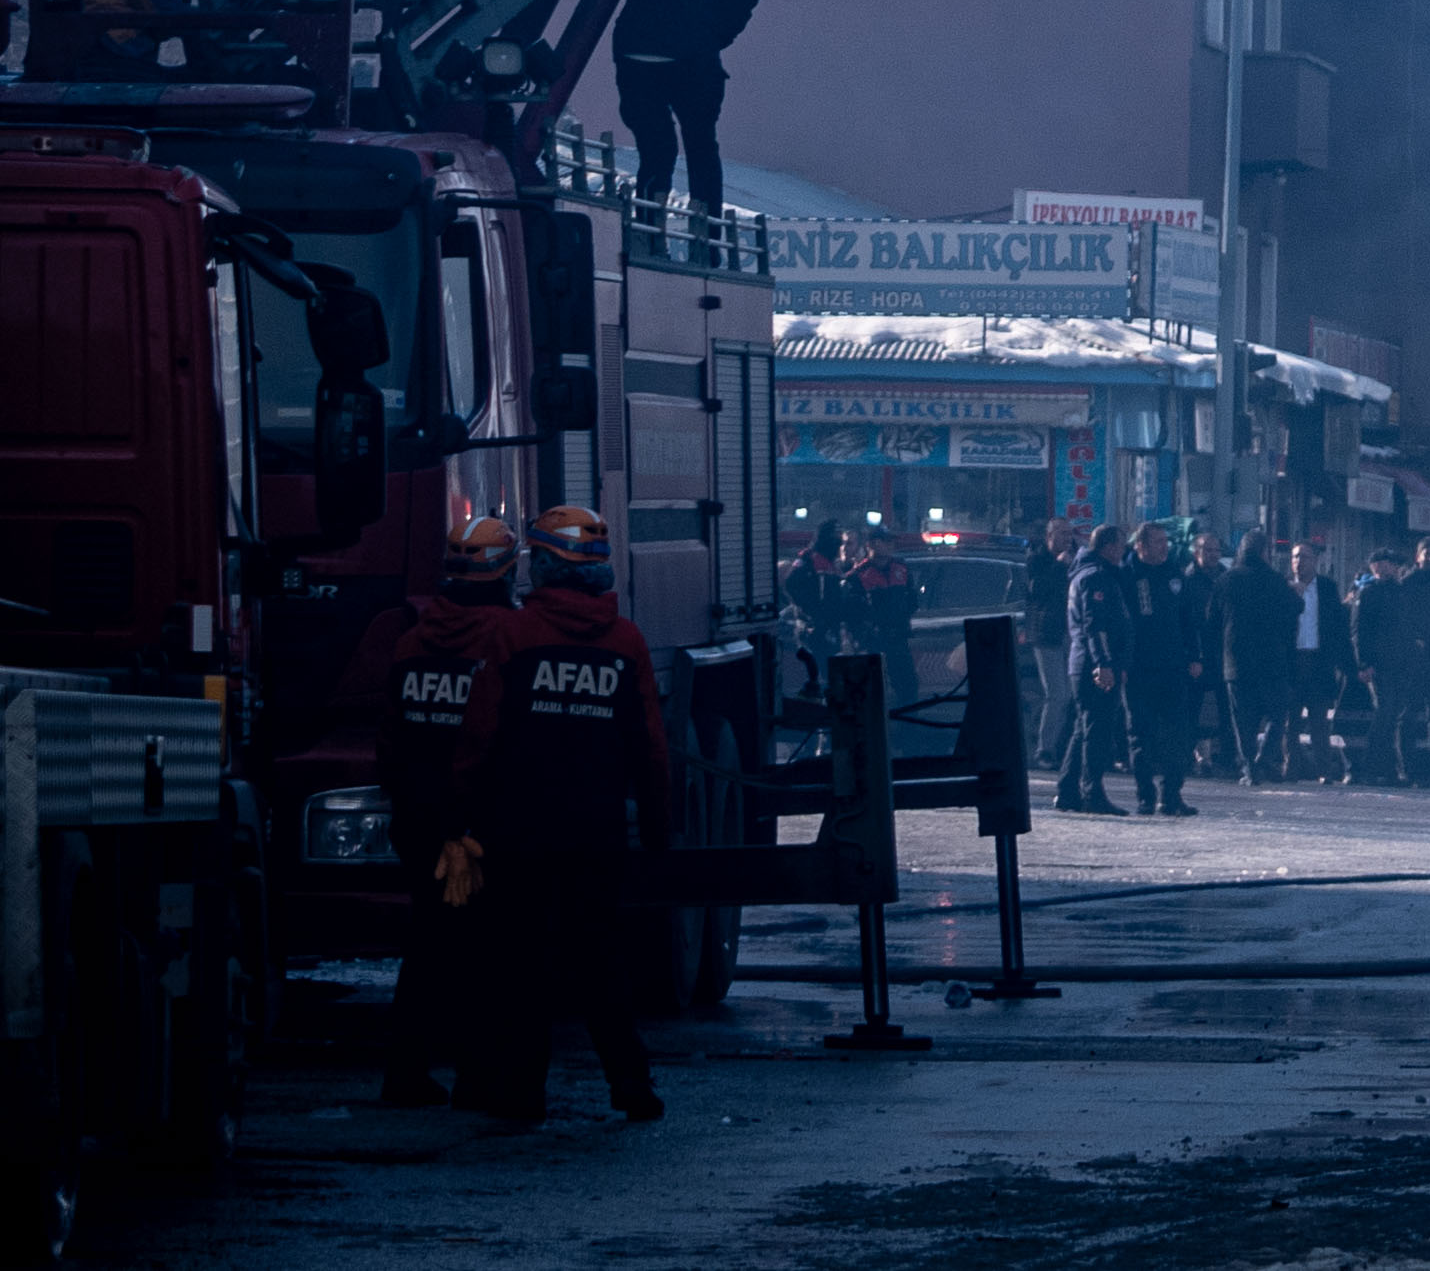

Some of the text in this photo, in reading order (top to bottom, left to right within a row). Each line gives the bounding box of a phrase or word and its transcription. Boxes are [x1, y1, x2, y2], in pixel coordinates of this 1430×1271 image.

[869, 230, 1115, 280] BALIKÇILIK
[809, 287, 854, 306] RİZE
[872, 290, 925, 308] HOPA
[402, 671, 472, 704] AFAD
[532, 659, 620, 697] AFAD
[531, 700, 614, 719] ARAMA KURTARMA
